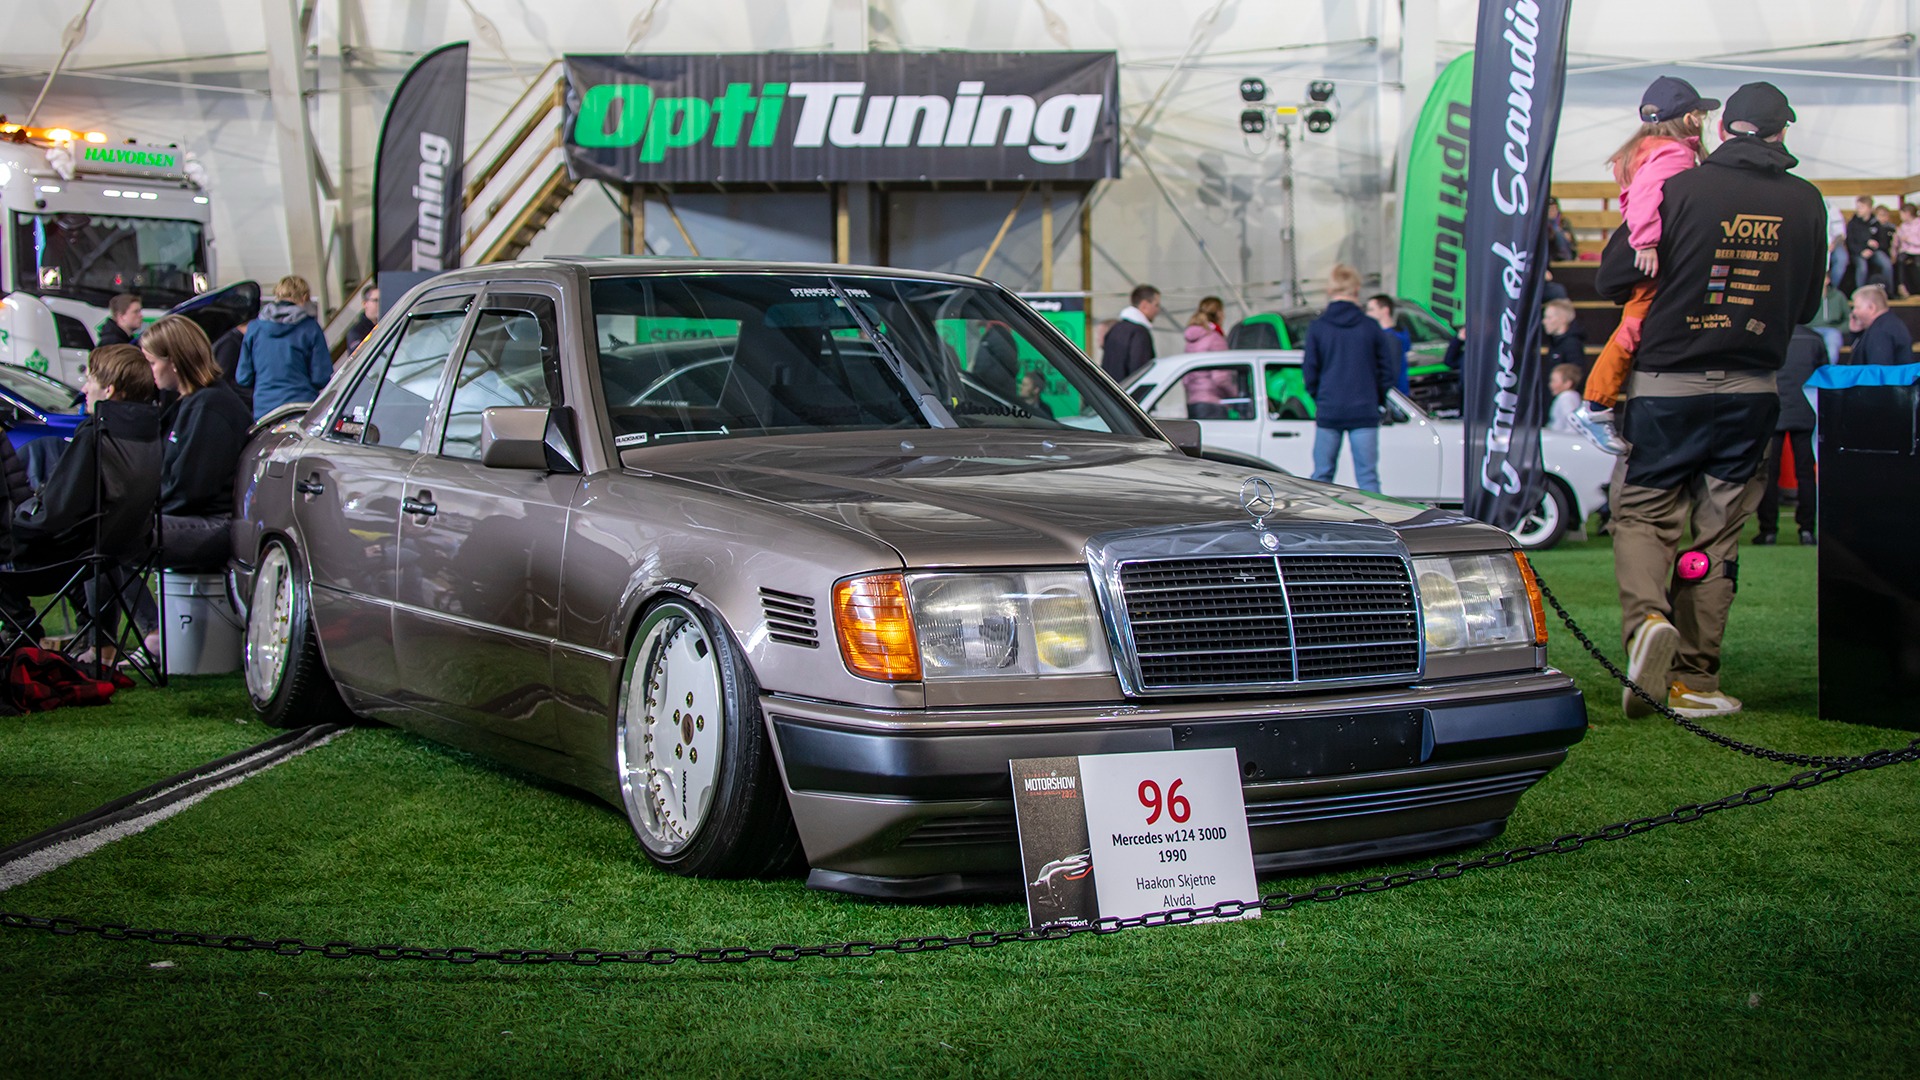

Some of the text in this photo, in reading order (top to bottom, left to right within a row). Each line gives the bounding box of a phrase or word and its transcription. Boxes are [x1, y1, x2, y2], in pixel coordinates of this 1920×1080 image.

[574, 81, 1103, 165] OptiTuning
[84, 147, 175, 167] HALVORSEN
[1721, 214, 1783, 239] VOKK
[1715, 248, 1779, 262] BEER TOUR 2020
[1024, 776, 1076, 792] MOTORSHOW
[1137, 777, 1191, 826] 96
[1112, 827, 1227, 846] Mercedes w124 300D
[1158, 848, 1187, 863] 1990
[1136, 874, 1216, 890] Haakon Skjetne
[1163, 893, 1196, 907] Alvdal
